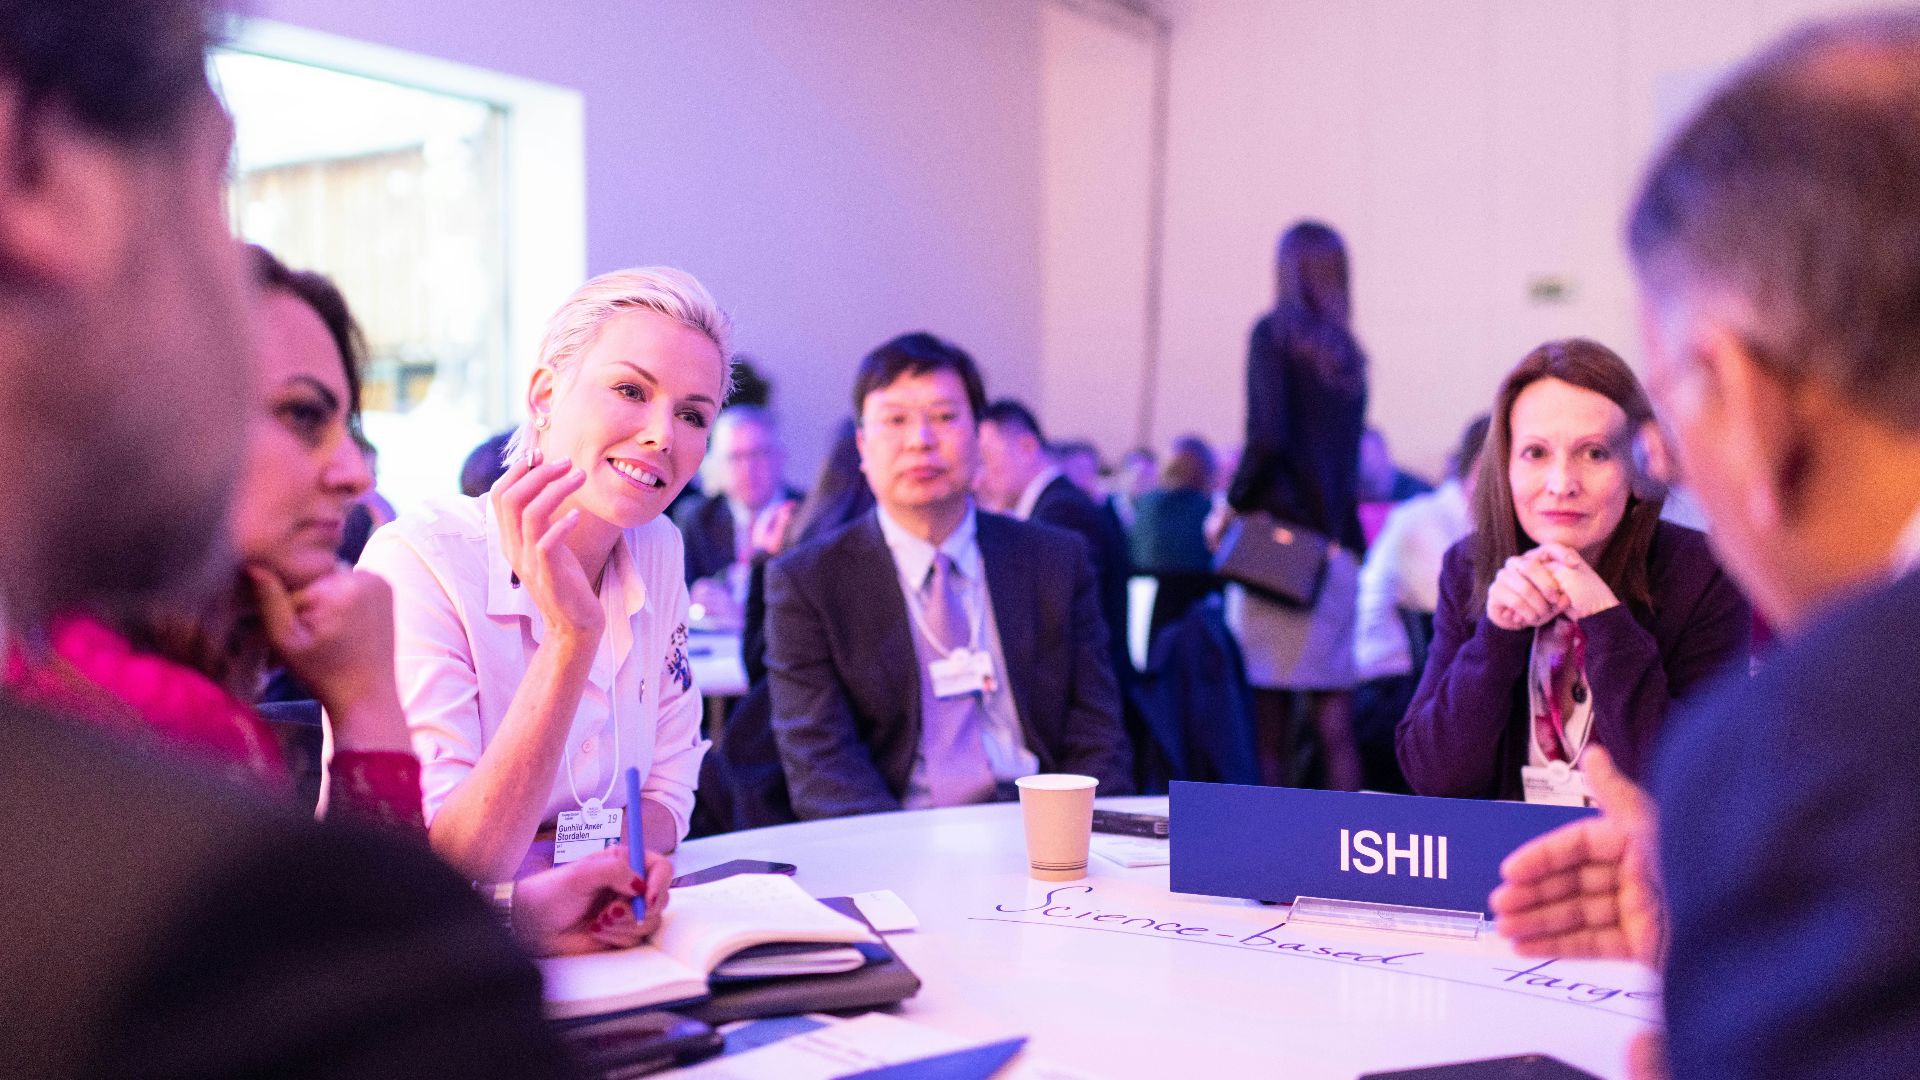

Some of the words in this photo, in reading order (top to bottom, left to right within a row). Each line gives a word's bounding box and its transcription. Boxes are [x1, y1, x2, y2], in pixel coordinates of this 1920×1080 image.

[607, 813, 618, 824] 19
[557, 831, 590, 841] Stordalen
[1340, 829, 1448, 880] ISHII
[995, 884, 1424, 966] Science-based
